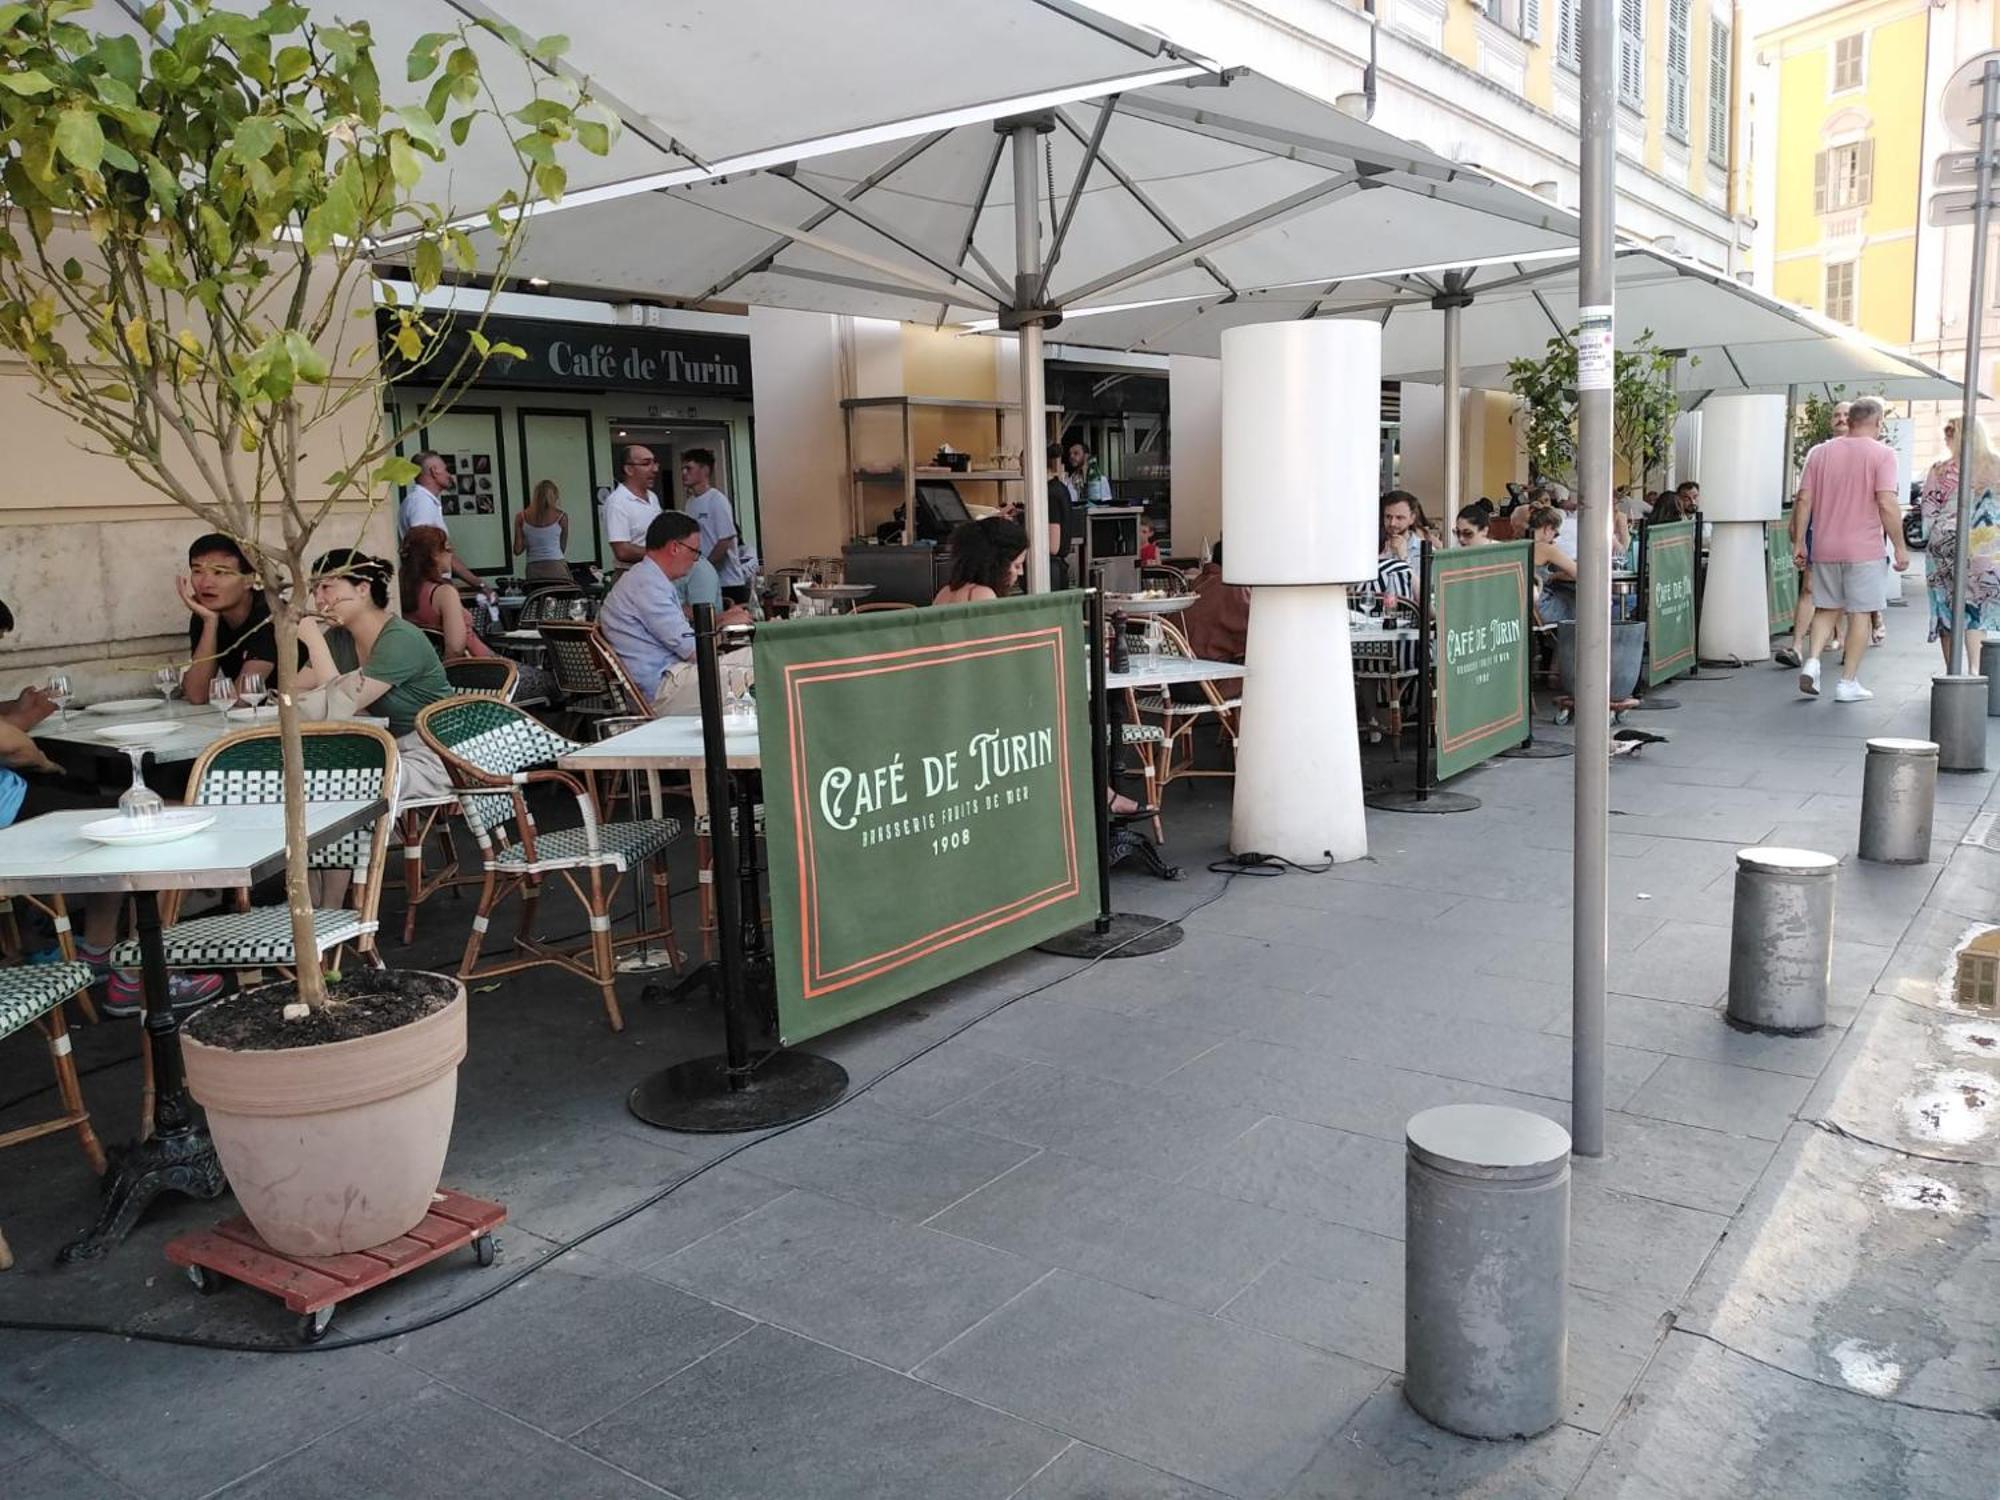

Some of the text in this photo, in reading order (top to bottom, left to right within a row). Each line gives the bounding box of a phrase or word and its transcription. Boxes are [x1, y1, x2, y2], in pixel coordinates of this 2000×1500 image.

[548, 341, 739, 385] Café de Turin
[819, 728, 1053, 831] CAFÉ DE TURIN
[862, 785, 1030, 848] BRASSERIE FRUITS DE MER
[931, 828, 970, 856] 1908
